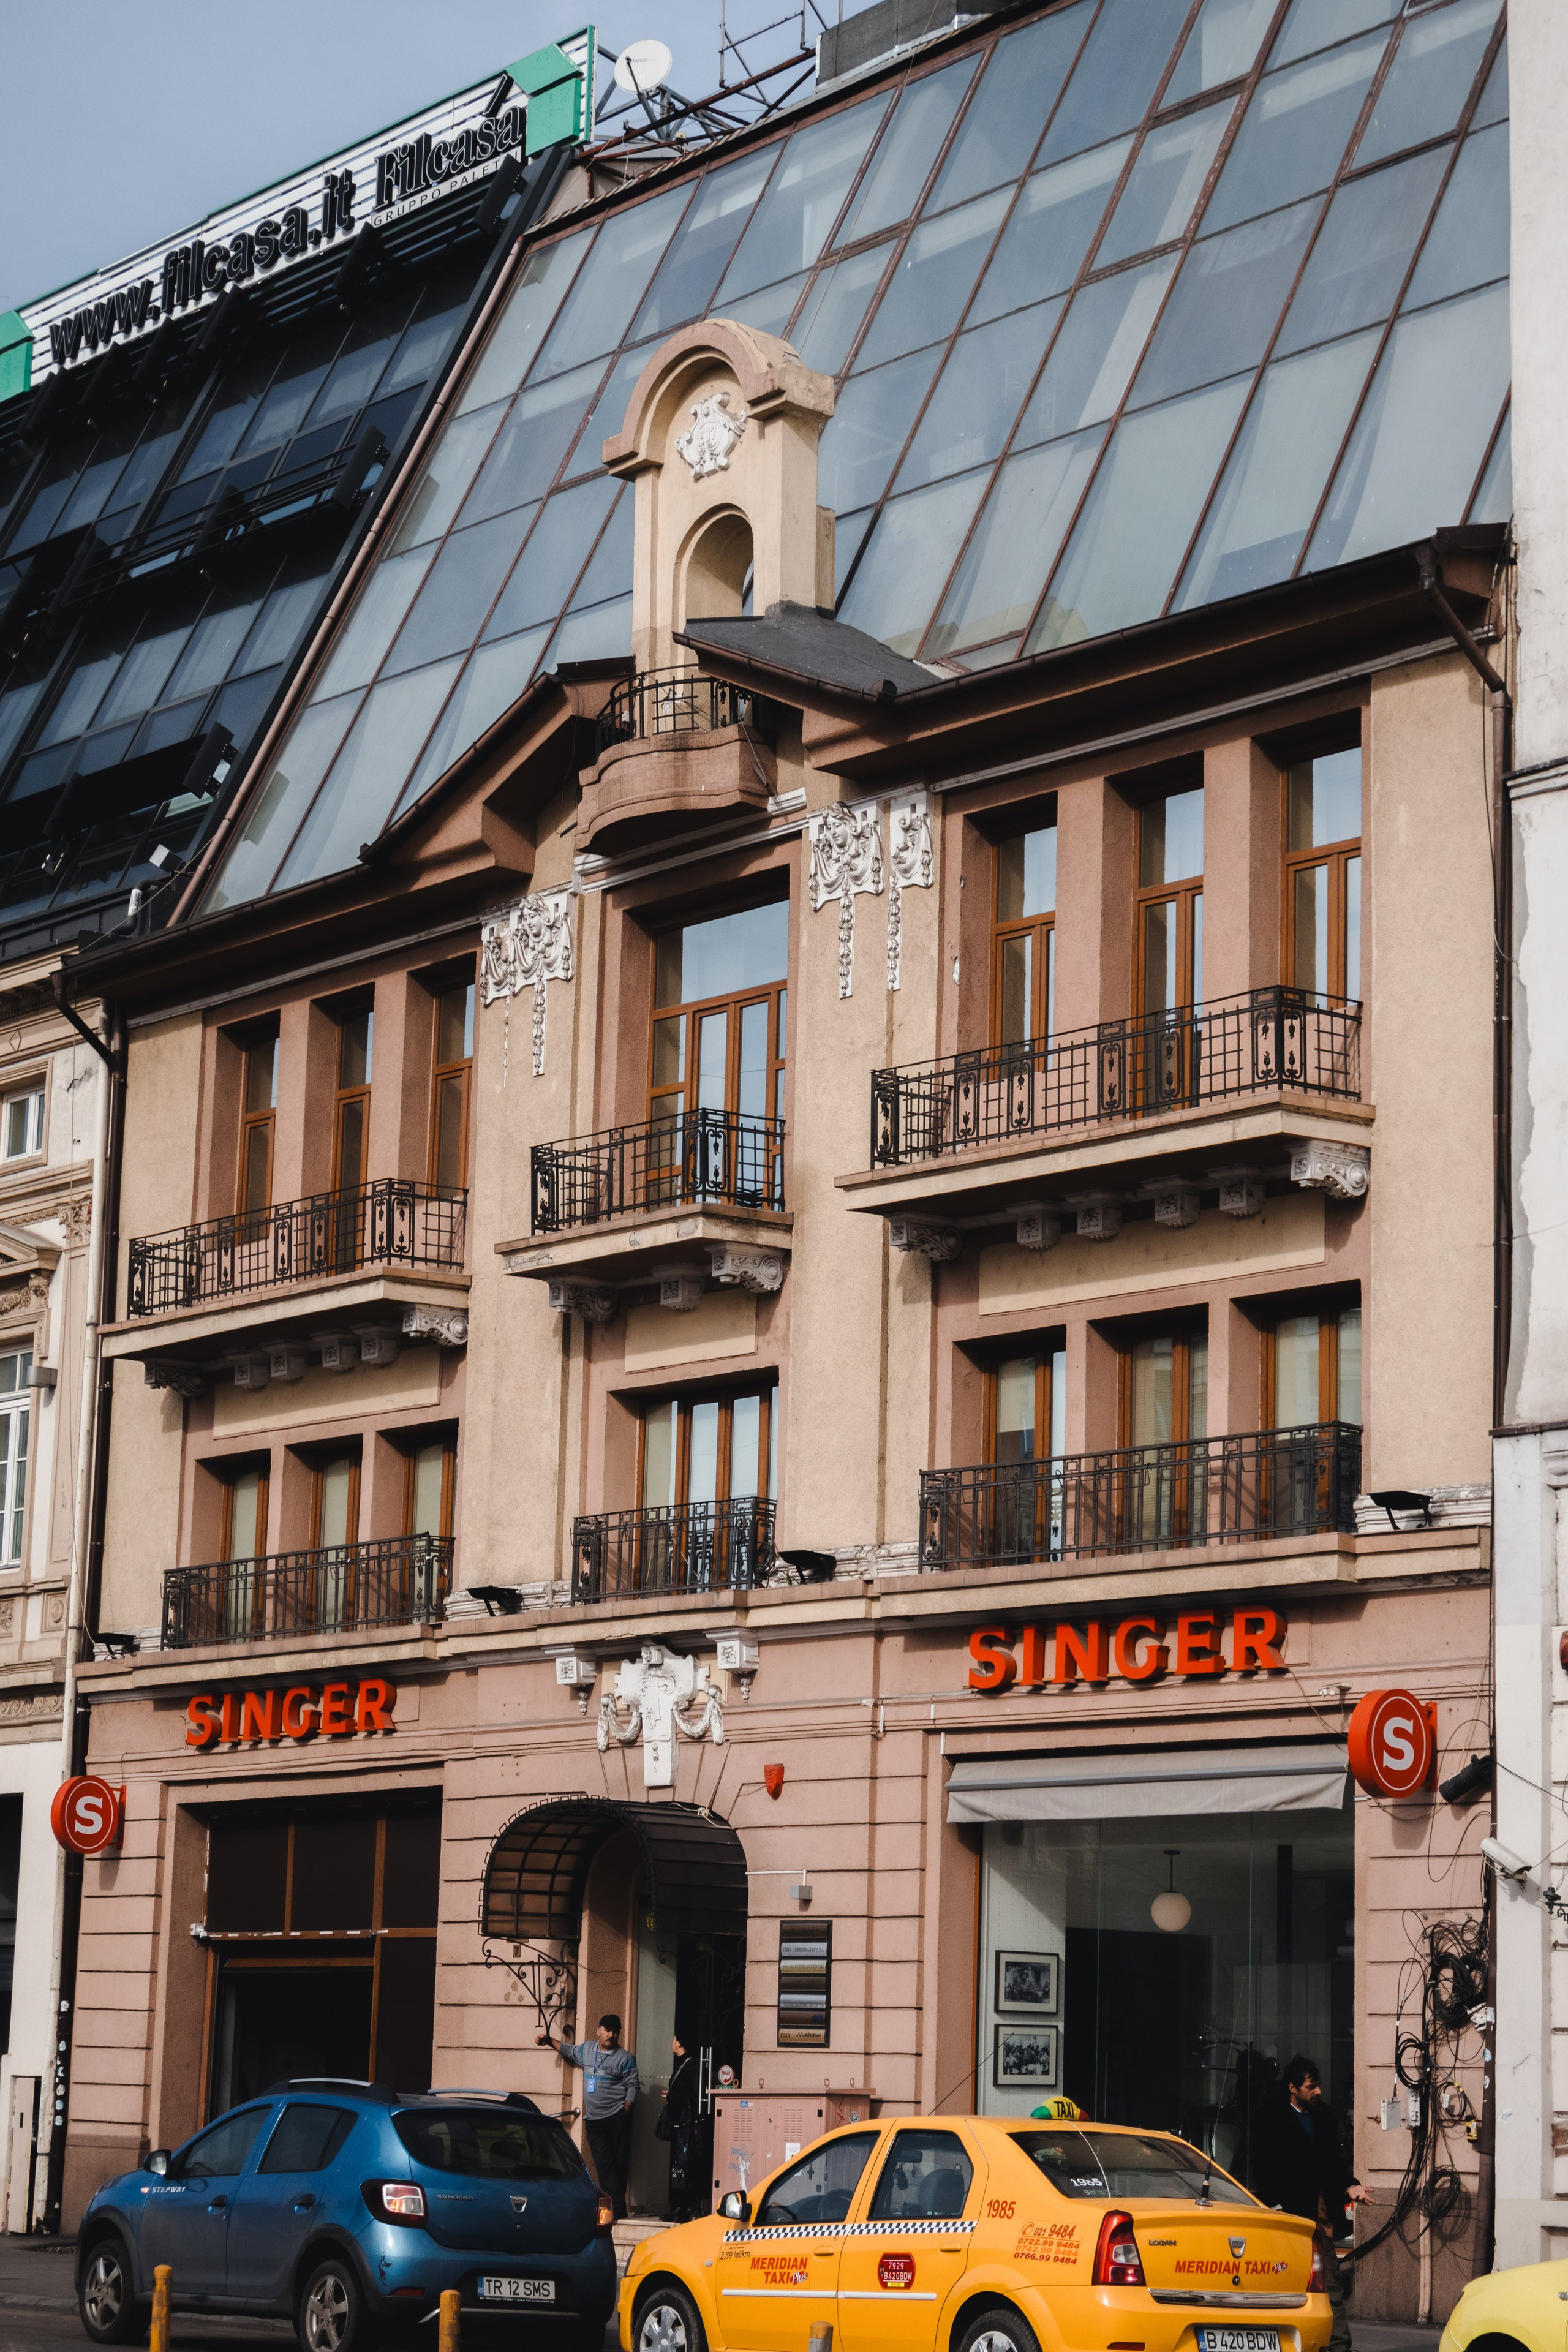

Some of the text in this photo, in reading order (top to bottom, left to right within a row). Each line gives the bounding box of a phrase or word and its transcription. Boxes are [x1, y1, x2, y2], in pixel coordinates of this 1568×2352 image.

[374, 189, 442, 227] GRUPPO
[49, 167, 356, 365] www.filcasa.it
[968, 1605, 1289, 1691] SINGER
[186, 1678, 396, 1748] SINGER
[1381, 1716, 1415, 1771] S
[74, 1795, 104, 1835] S
[1054, 2101, 1074, 2119] TAXI
[987, 2199, 1016, 2220] 1985
[1033, 2223, 1076, 2239] 021 9484
[1016, 2245, 1079, 2257] 0742.99 9484
[1017, 2237, 1080, 2250] 0722.99 9484
[720, 2250, 750, 2260] 2,89 lei/km
[750, 2257, 808, 2270] MERIDIAN
[1014, 2252, 1050, 2261] 0766.99
[1174, 2260, 1288, 2274] MERIDIAN TAXI Plus
[764, 2270, 807, 2284] TAXI Plus
[486, 2279, 502, 2294] TR
[507, 2280, 519, 2296] 12
[523, 2281, 551, 2297] SMS
[1206, 2332, 1217, 2349] B
[1221, 2332, 1245, 2350] 420
[1246, 2332, 1276, 2351] BDW
